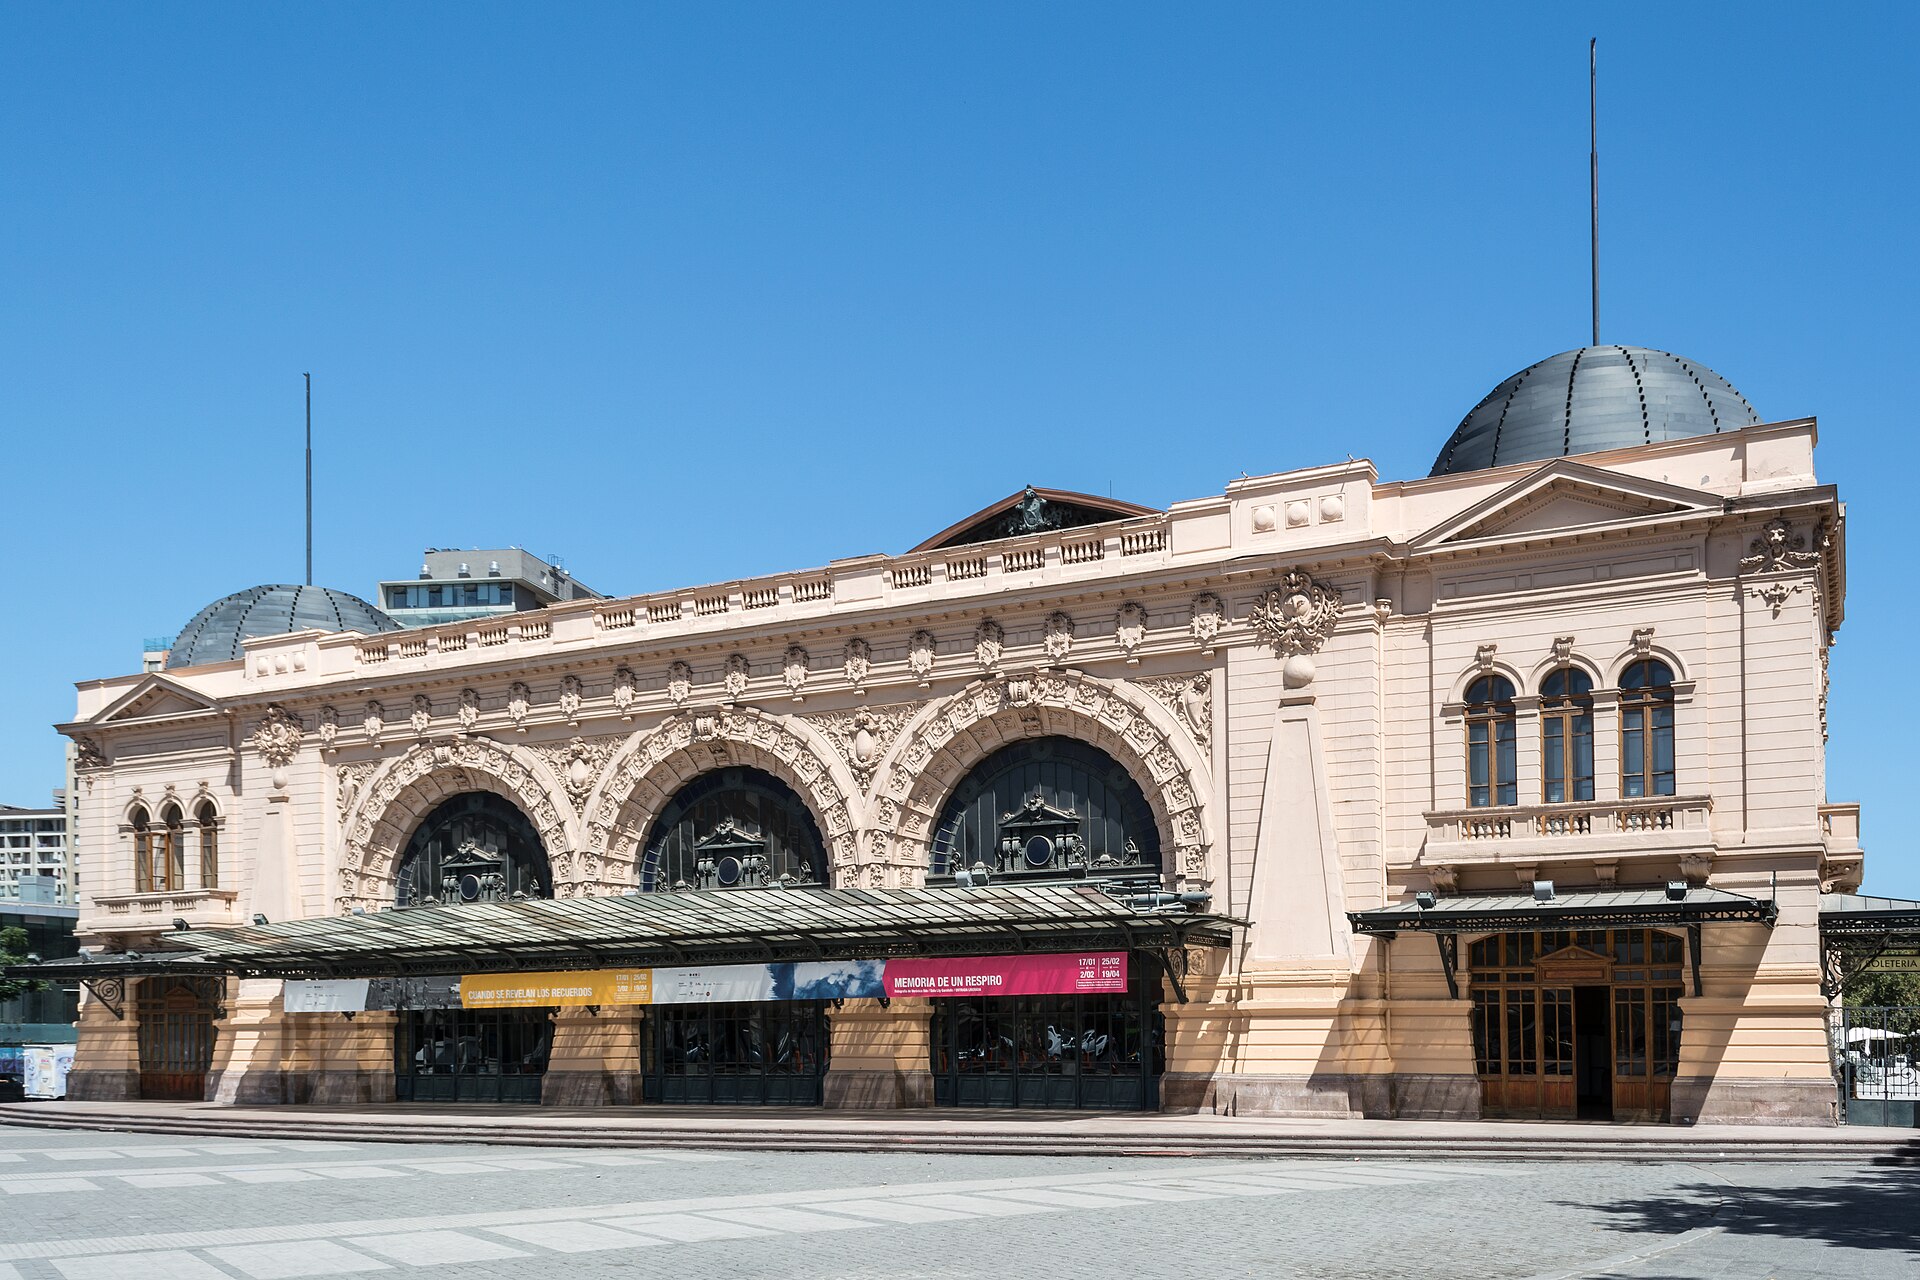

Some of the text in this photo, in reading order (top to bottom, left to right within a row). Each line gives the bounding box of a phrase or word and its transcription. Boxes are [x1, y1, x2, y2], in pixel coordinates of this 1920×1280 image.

[1079, 958, 1096, 966] 17/01
[1101, 957, 1120, 965] 25/02
[1079, 970, 1095, 979] 2/02
[1101, 970, 1120, 978] 19/04
[894, 975, 1003, 988] MEMORIA DE UN RESPIRO
[468, 987, 593, 1000] CUANDO SE REVELAN LOS RECUERDOS
